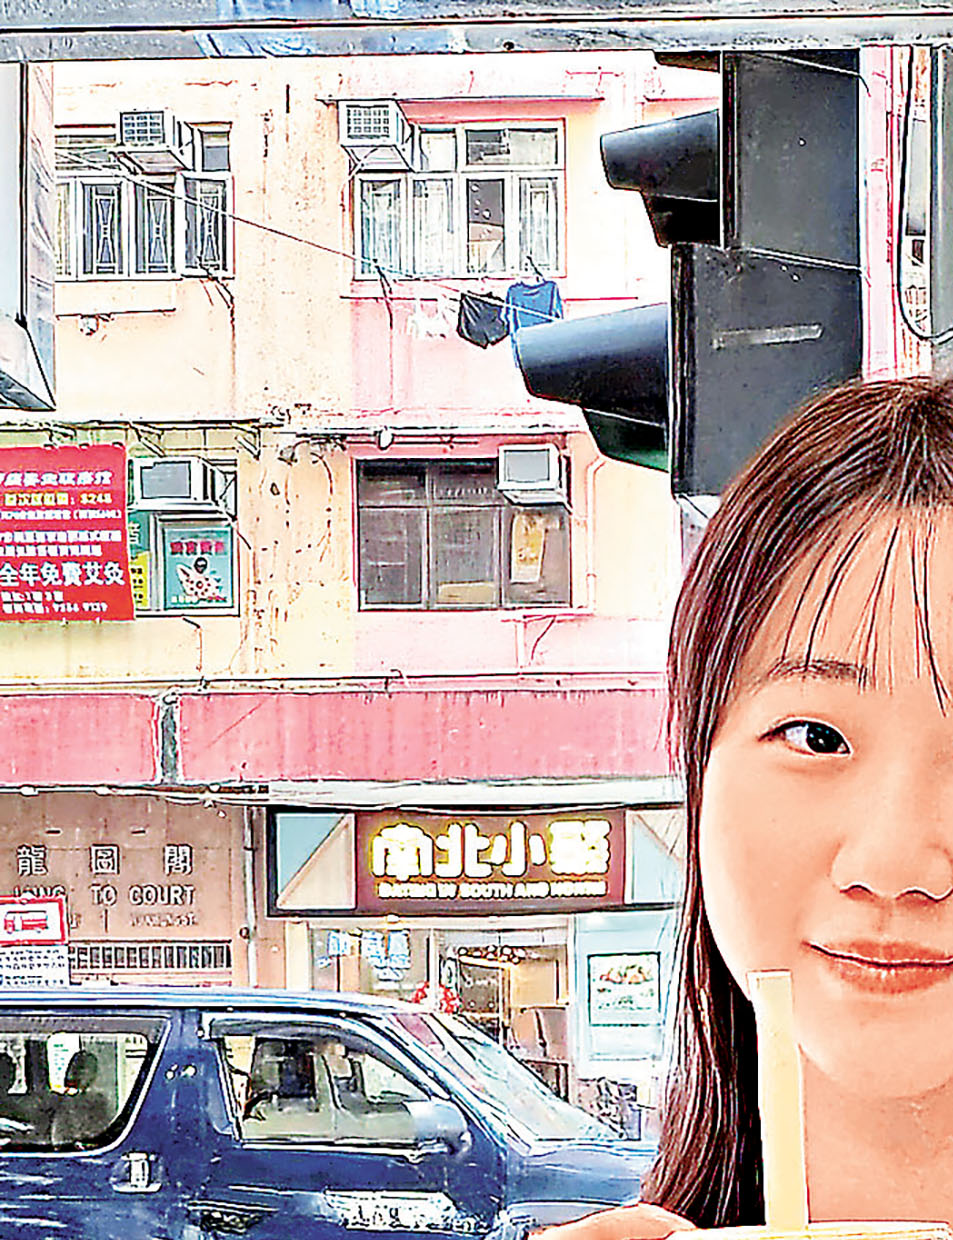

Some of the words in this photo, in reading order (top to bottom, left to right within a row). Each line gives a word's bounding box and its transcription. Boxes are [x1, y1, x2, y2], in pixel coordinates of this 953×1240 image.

[0, 561, 125, 587] 全年免費艾灸
[17, 844, 193, 876] 龍圖閣
[90, 884, 117, 906] TO
[128, 884, 196, 906] COURT
